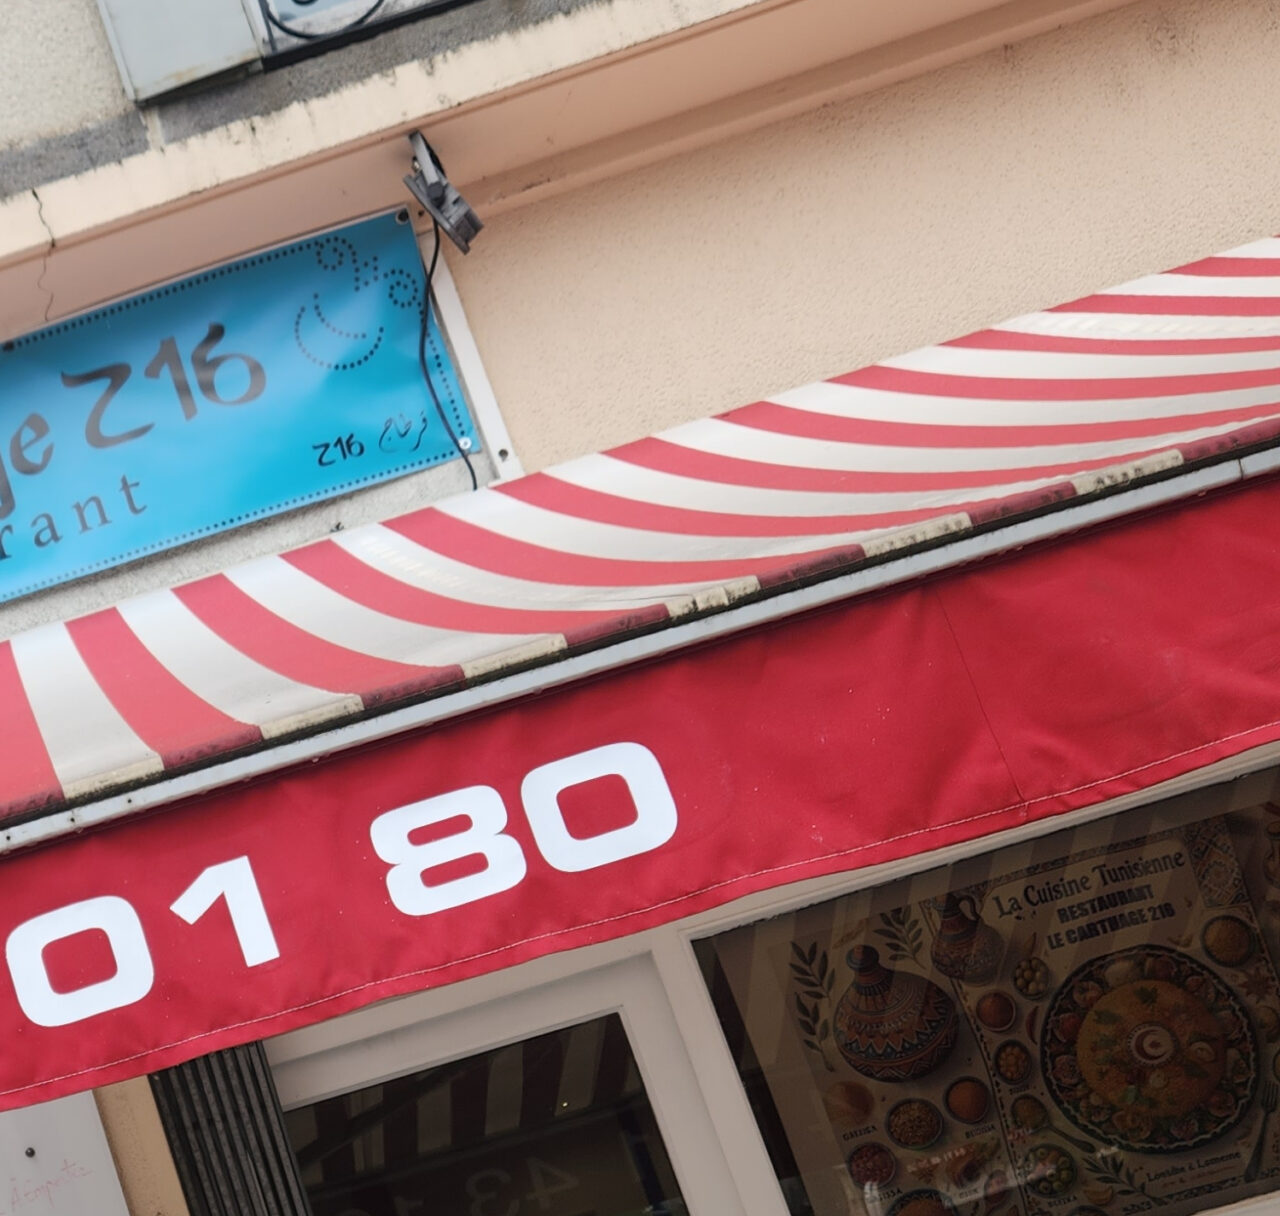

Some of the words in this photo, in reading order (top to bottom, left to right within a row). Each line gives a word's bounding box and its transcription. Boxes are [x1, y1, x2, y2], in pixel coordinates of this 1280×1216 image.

[60, 322, 267, 449] 216
[312, 433, 365, 467] 216
[5, 855, 281, 1027] 01
[369, 741, 678, 916] 80
[992, 895, 1023, 918] La
[1023, 875, 1092, 907] Cuisine
[1091, 851, 1185, 887] Tunisienne
[1057, 884, 1154, 924] RESTAURANT
[1047, 931, 1065, 950] LE
[1065, 908, 1148, 944] CARTHAGE
